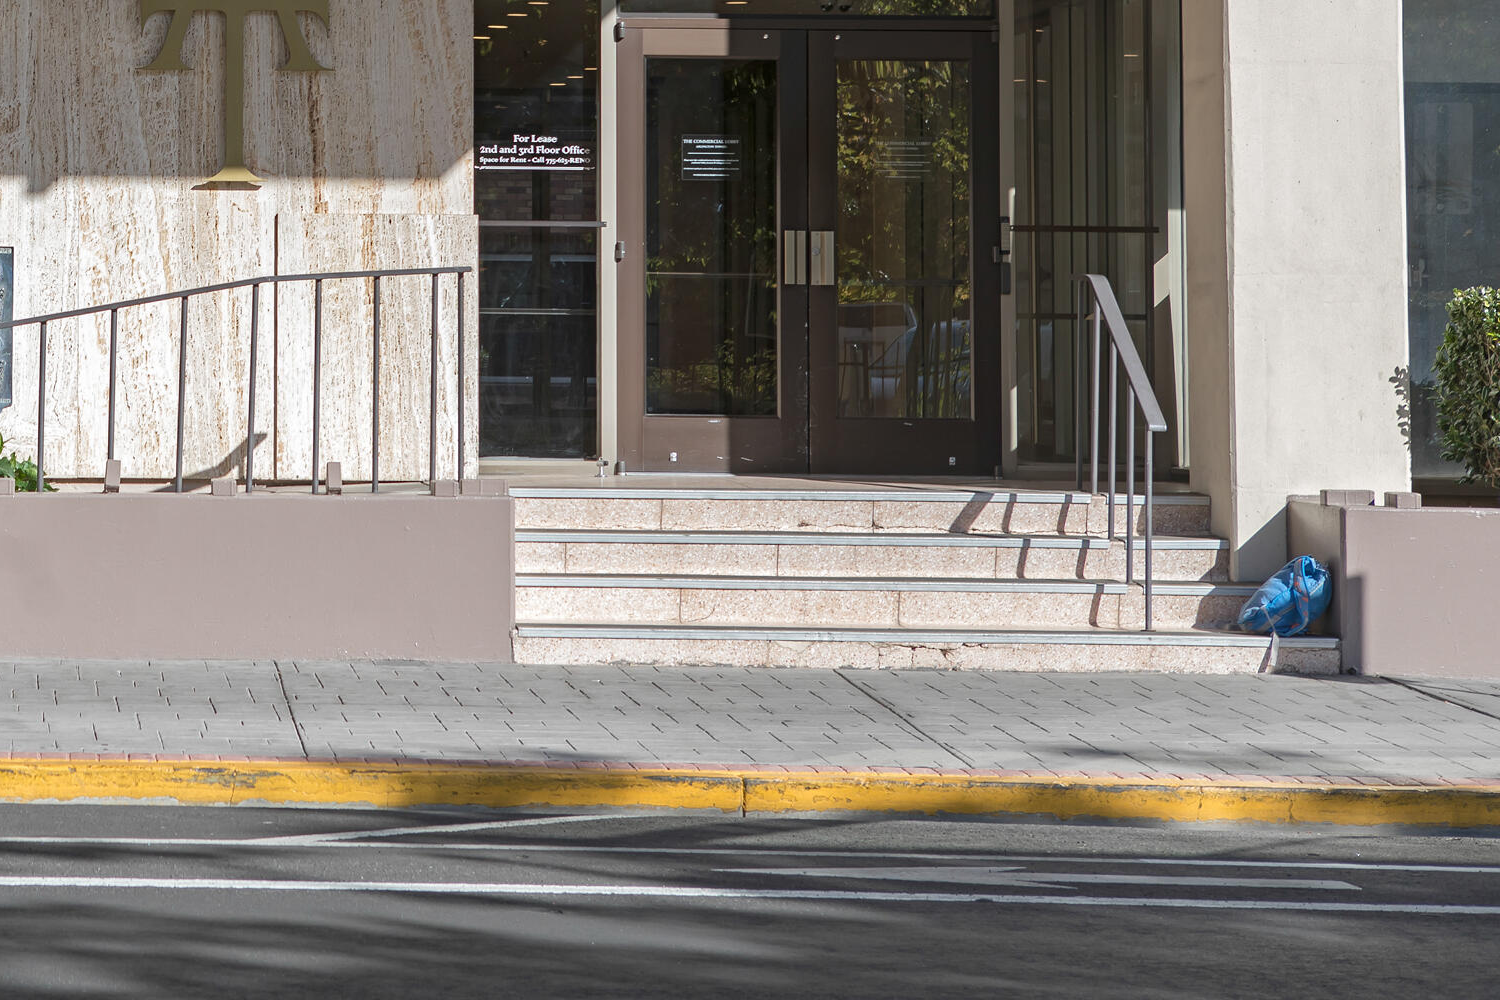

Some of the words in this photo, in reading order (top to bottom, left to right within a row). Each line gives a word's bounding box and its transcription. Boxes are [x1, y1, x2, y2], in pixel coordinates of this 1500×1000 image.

[513, 134, 529, 143] For
[531, 134, 558, 143] Lease
[480, 145, 498, 154] 2nd
[499, 145, 517, 154] and
[518, 145, 534, 156] 3rd
[536, 145, 560, 154] Floor
[561, 145, 591, 155] Office
[479, 156, 498, 165] Space
[531, 156, 545, 164] Call
